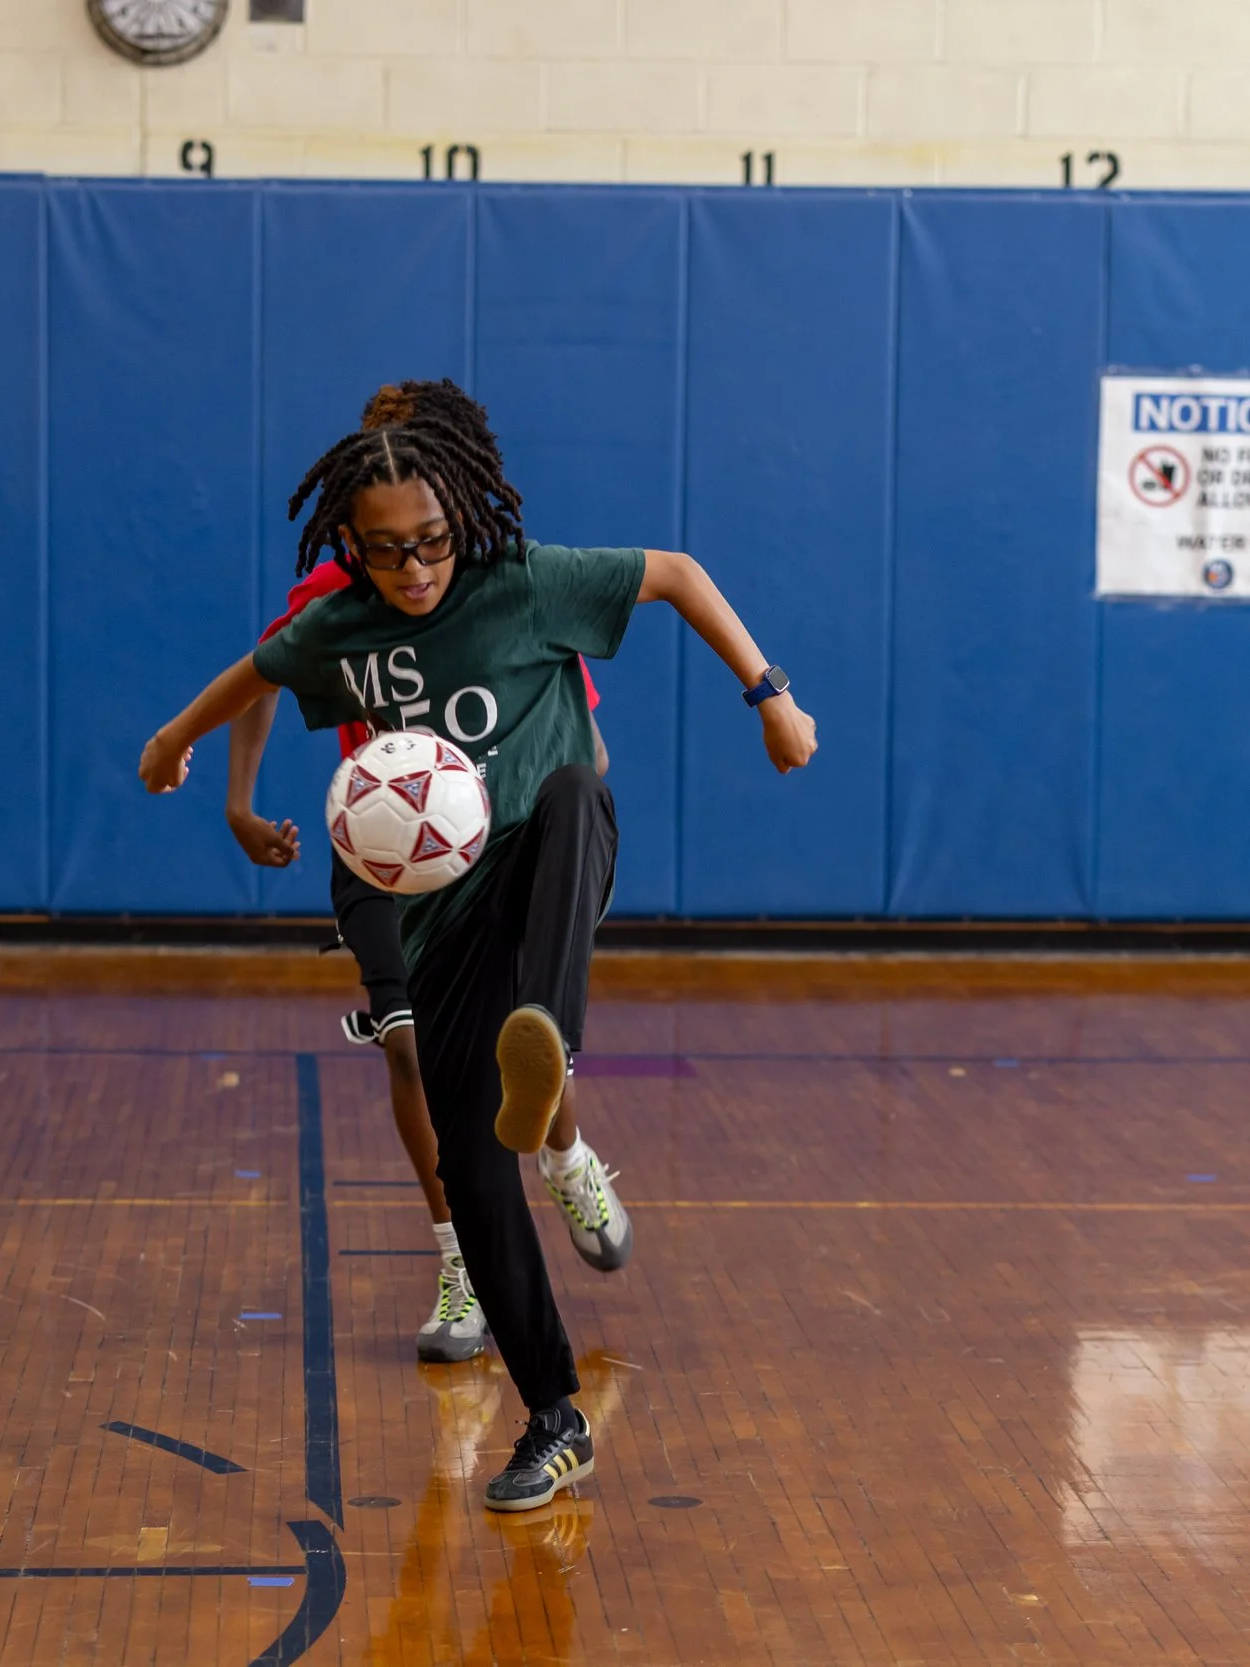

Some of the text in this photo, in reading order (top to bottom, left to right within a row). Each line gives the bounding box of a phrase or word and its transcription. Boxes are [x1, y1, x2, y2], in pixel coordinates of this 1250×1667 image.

[180, 139, 214, 179] 9
[421, 143, 480, 181] 10
[740, 149, 775, 187] 11
[1061, 151, 1120, 190] 12
[1196, 491, 1250, 508] ALLO
[340, 645, 425, 709] MS
